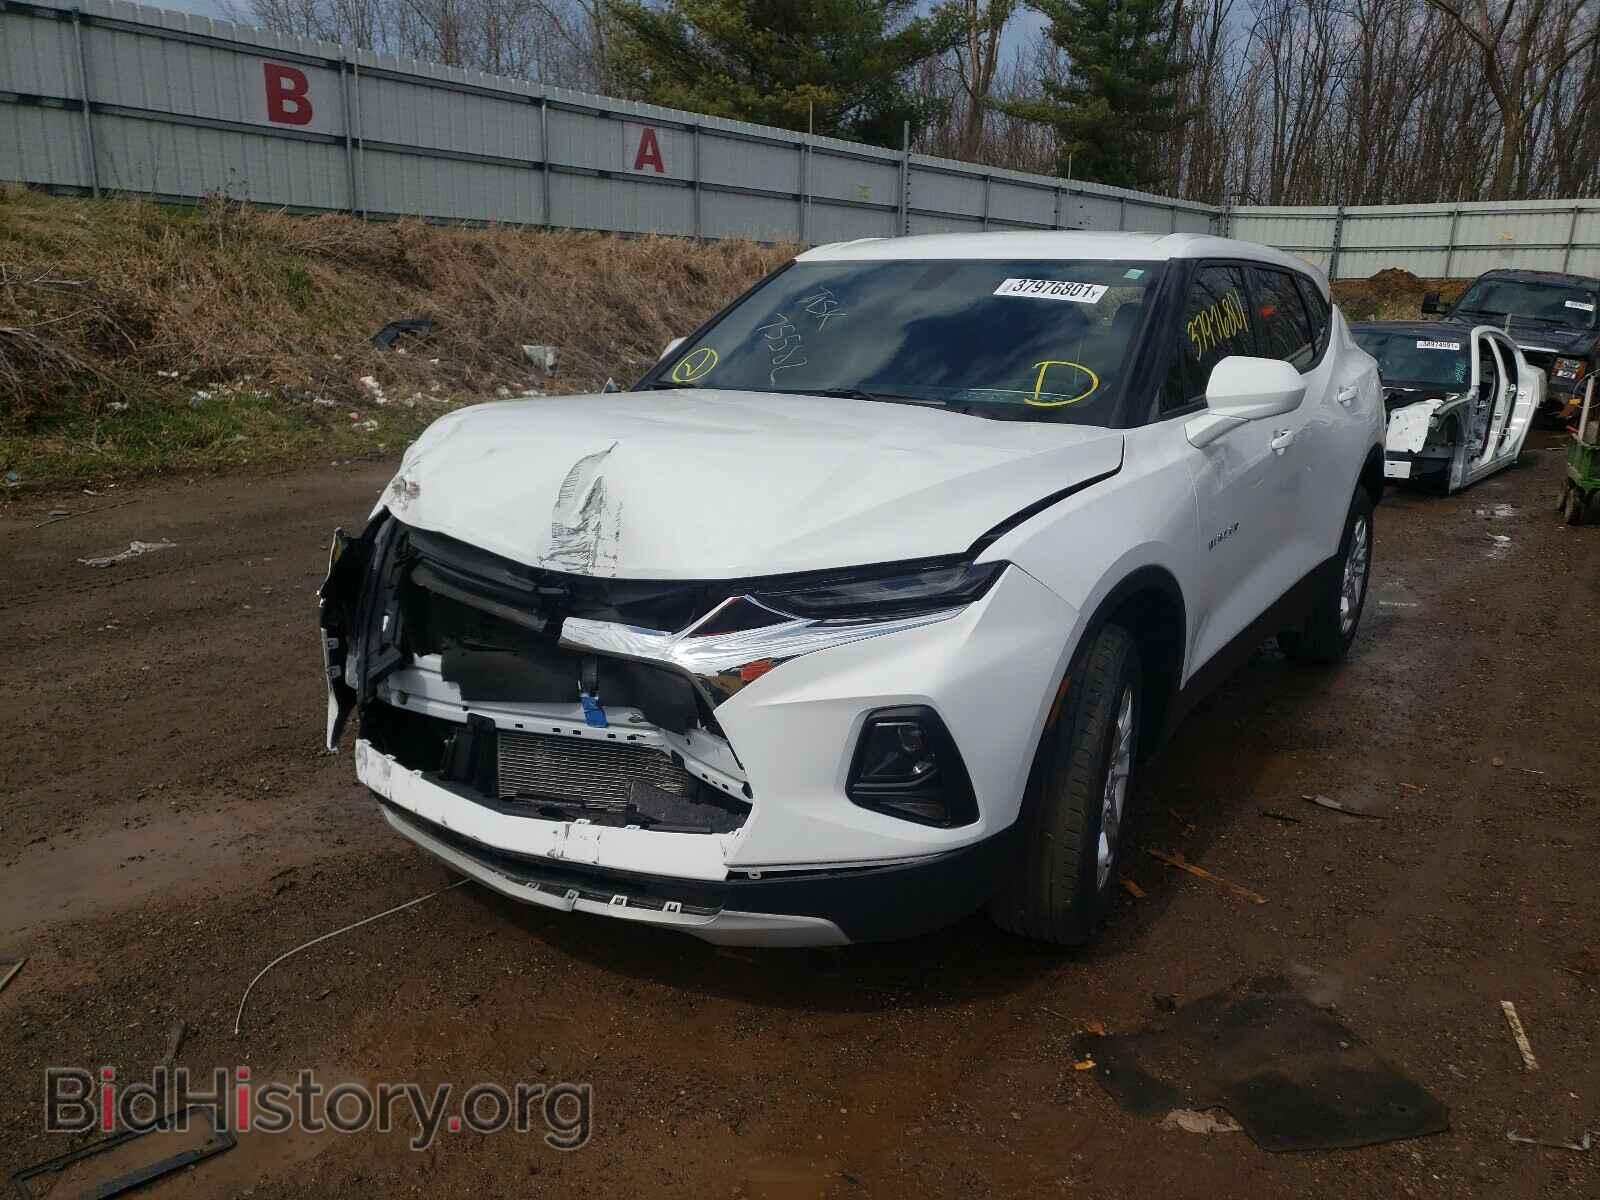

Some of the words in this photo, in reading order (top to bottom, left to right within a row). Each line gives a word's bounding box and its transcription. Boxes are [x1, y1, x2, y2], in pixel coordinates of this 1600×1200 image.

[264, 62, 313, 125] B
[634, 128, 665, 173] A
[1012, 279, 1092, 298] 37976801
[1024, 360, 1100, 407] D
